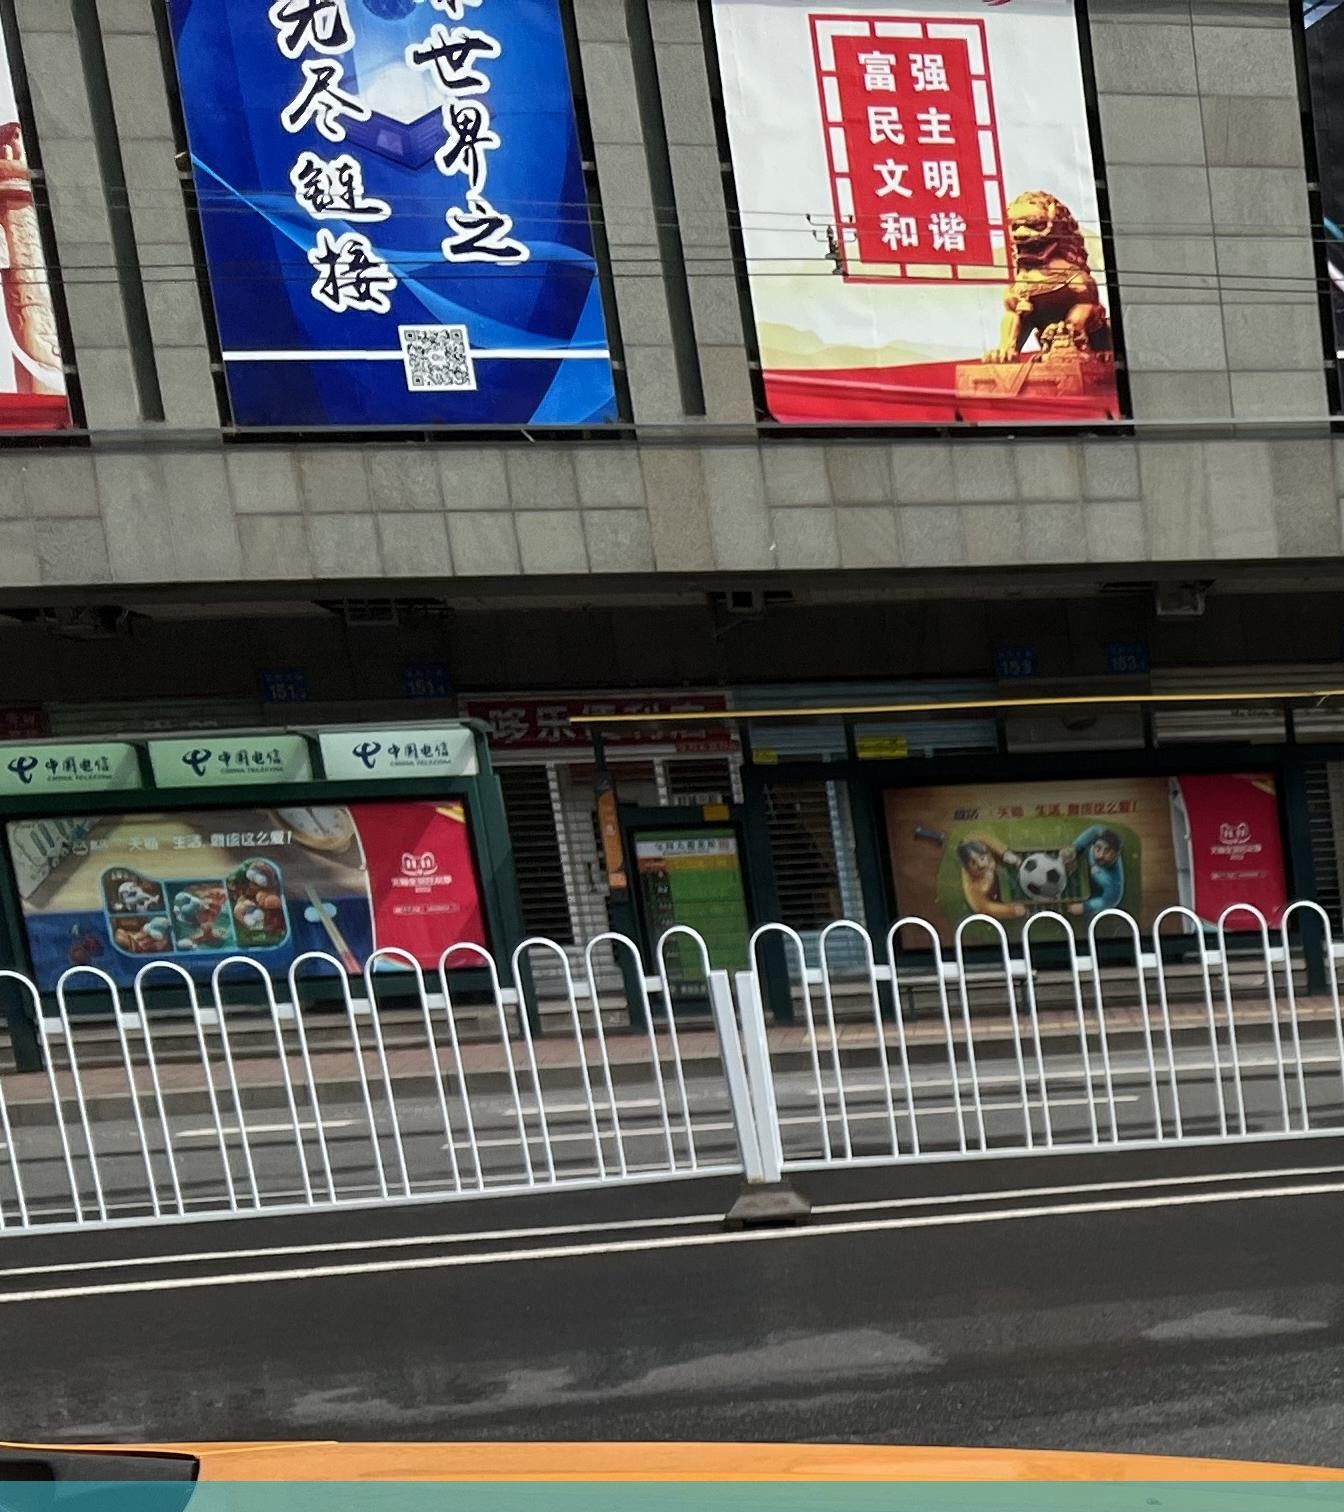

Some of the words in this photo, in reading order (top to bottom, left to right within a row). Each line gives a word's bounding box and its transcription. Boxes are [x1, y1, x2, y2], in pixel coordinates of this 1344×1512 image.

[858, 51, 950, 93] 富强
[408, 0, 528, 263] 世界之
[868, 105, 957, 145] 民主
[873, 159, 962, 198] 文明
[881, 211, 968, 253] 和谐
[44, 756, 110, 775] 中国电信
[218, 748, 283, 767] 中国电信
[388, 741, 449, 760] 中国电信
